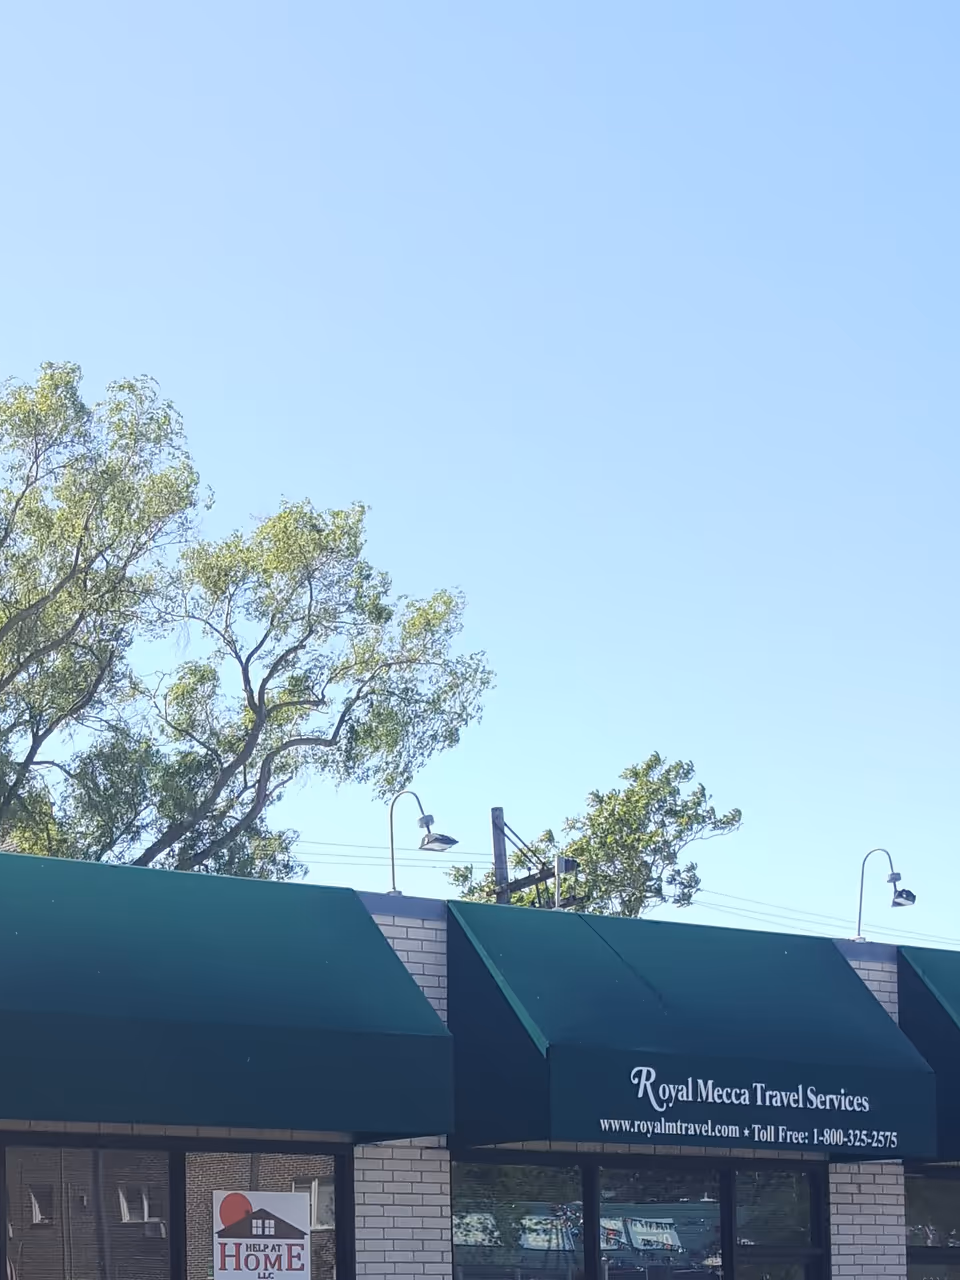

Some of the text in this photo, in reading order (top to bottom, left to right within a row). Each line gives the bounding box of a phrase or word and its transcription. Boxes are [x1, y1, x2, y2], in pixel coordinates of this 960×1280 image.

[630, 1066, 870, 1112] Royal Mecca Travel Services
[599, 1118, 898, 1148] www.royalmtravel.com Toll Free: 1-800-325-2575
[218, 1242, 305, 1272] HOME
[245, 1243, 283, 1253] HELP AT
[257, 1272, 275, 1280] LLC
